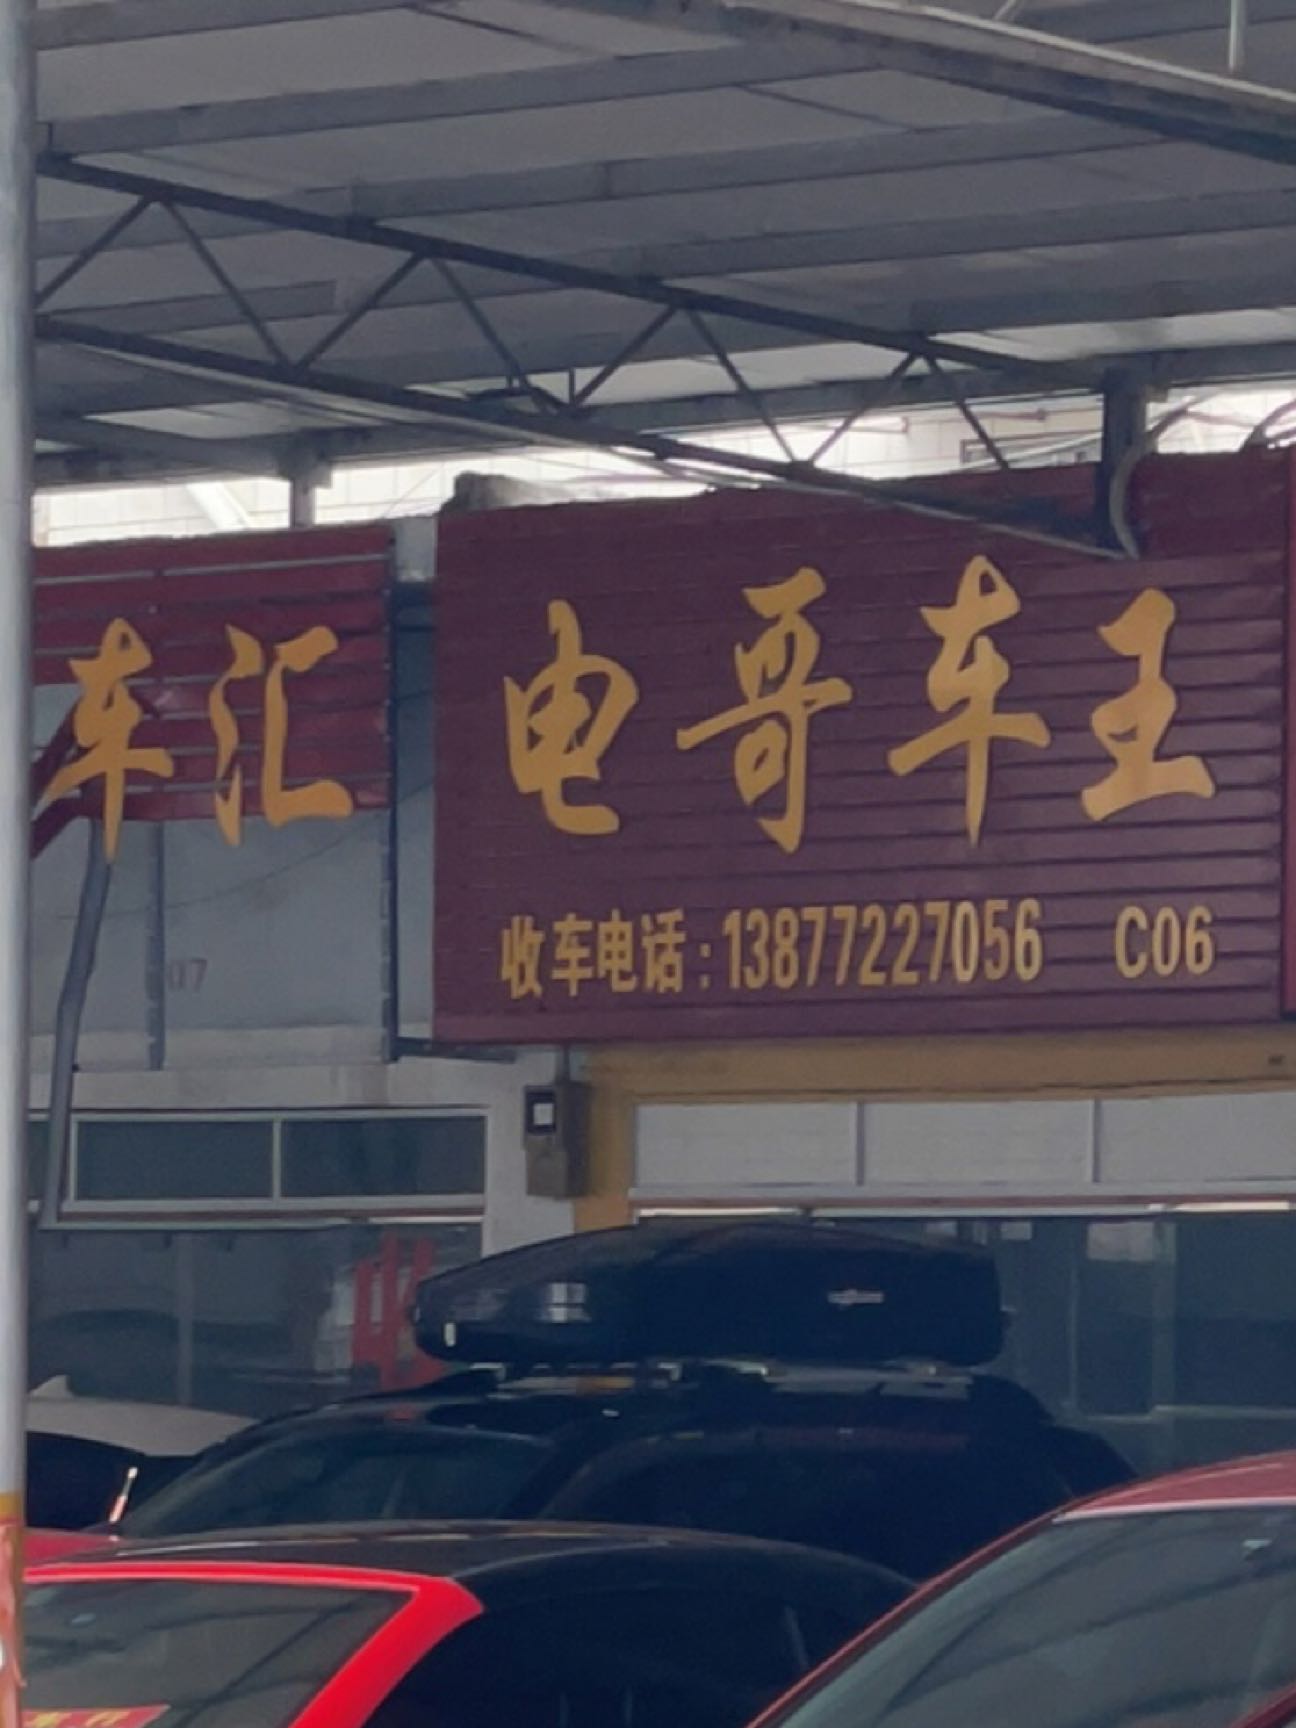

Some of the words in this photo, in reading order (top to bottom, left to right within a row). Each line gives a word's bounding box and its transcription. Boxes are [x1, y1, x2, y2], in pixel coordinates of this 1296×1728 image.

[503, 555, 1216, 855] 电哥车王
[1113, 906, 1216, 981] C06
